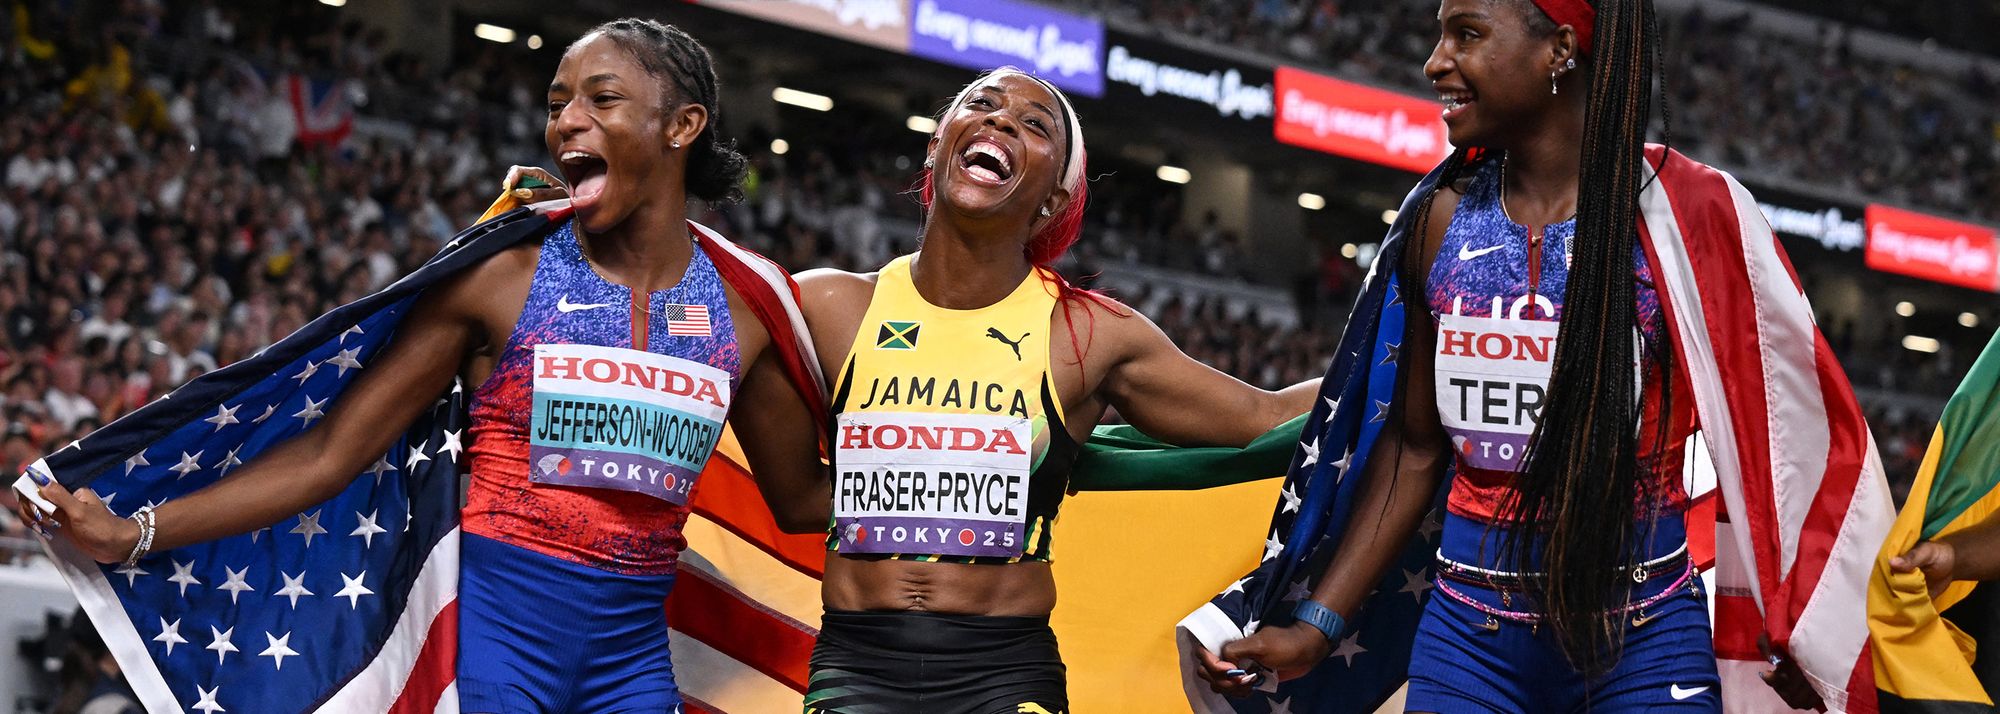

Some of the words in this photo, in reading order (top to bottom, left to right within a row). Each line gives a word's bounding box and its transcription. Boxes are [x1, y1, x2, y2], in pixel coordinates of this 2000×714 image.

[1440, 329, 1558, 363] HON
[538, 356, 726, 408] HONDA
[860, 376, 1029, 419] JAMAICA
[1449, 377, 1546, 426] TER
[537, 399, 717, 473] JEFFERSON-WOODEN
[840, 424, 1027, 455] HONDA
[841, 470, 1021, 516] FRASER-PRYCE
[873, 526, 976, 547] TOKYO
[982, 530, 1015, 547] 25
